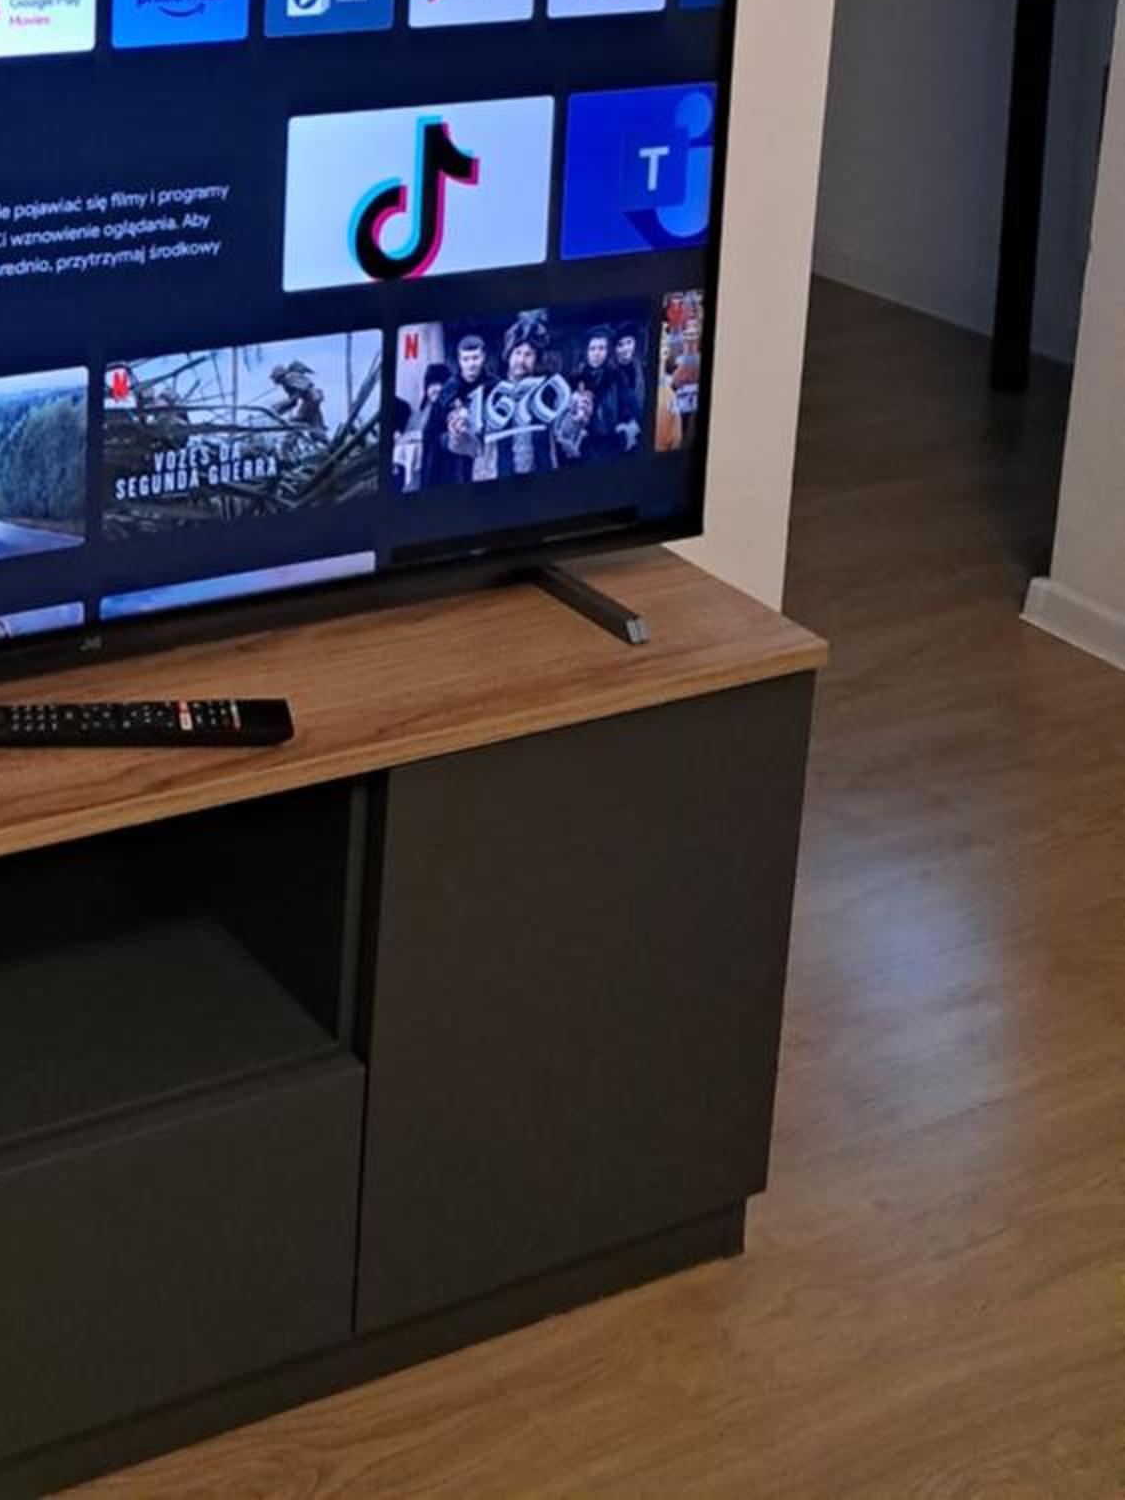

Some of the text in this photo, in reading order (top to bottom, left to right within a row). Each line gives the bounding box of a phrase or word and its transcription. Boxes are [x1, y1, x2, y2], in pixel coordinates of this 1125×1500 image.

[9, 14, 50, 27] Movies
[639, 146, 669, 191] T
[14, 197, 83, 221] pojawiać
[86, 194, 107, 213] się
[111, 192, 147, 209] filmy
[157, 184, 229, 206] programy
[10, 224, 100, 246] wznowienie
[103, 214, 177, 239] oglądania.
[182, 212, 210, 228] Aby
[56, 246, 145, 274] przytrzymaj
[149, 240, 221, 261] środkowy
[468, 373, 572, 434] 1670
[154, 442, 243, 472] VOZES DA
[115, 456, 278, 500] SEGUNDA GUERRA
